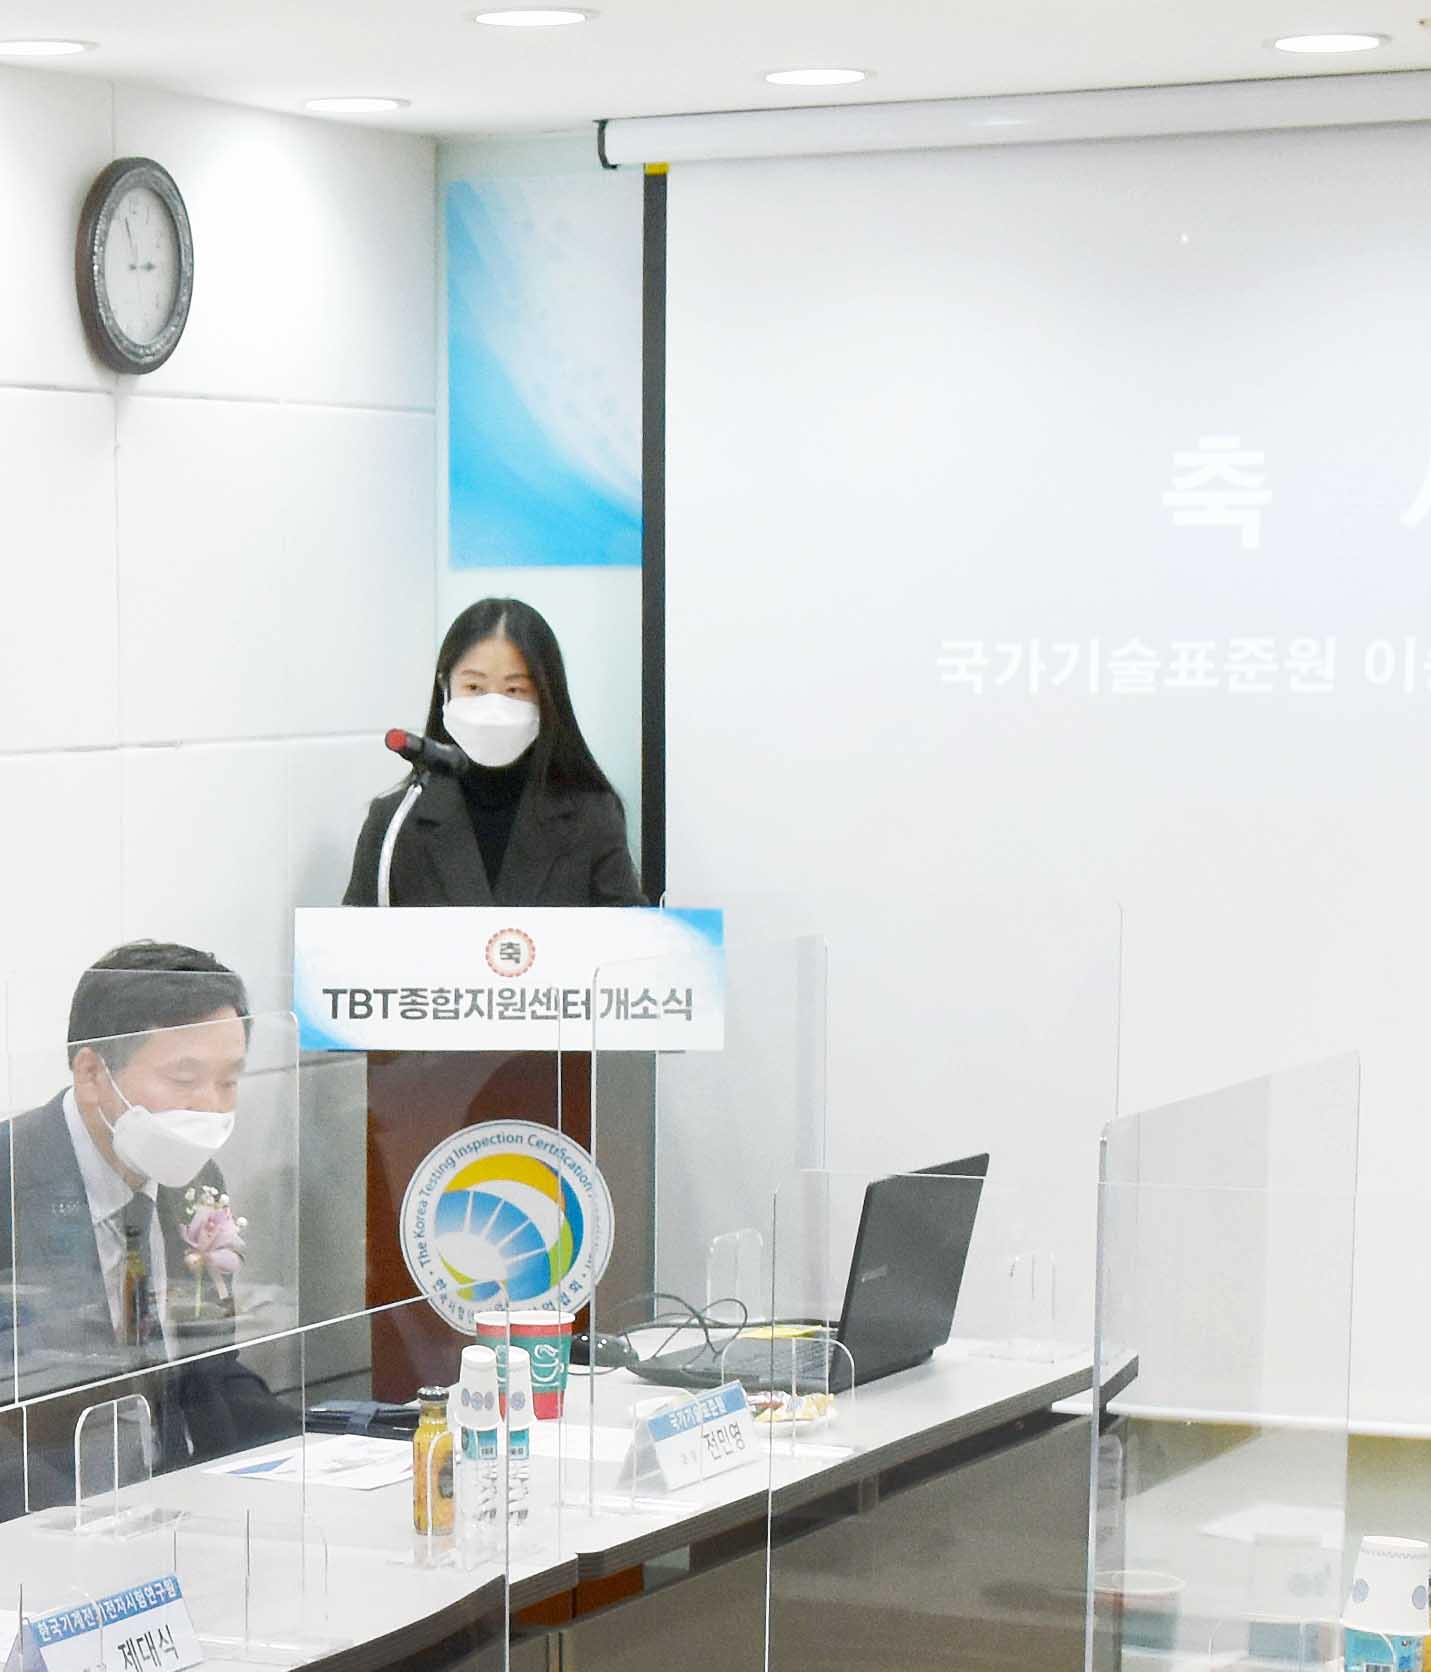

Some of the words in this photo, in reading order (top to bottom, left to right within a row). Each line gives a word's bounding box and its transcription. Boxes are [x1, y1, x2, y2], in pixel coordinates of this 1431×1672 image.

[1161, 433, 1273, 549] 축
[936, 637, 1338, 695] 국가기술표준원
[499, 941, 521, 964] 축
[456, 1131, 524, 1158] Inspection
[419, 1156, 457, 1199] Testing
[415, 1199, 429, 1243] Korea
